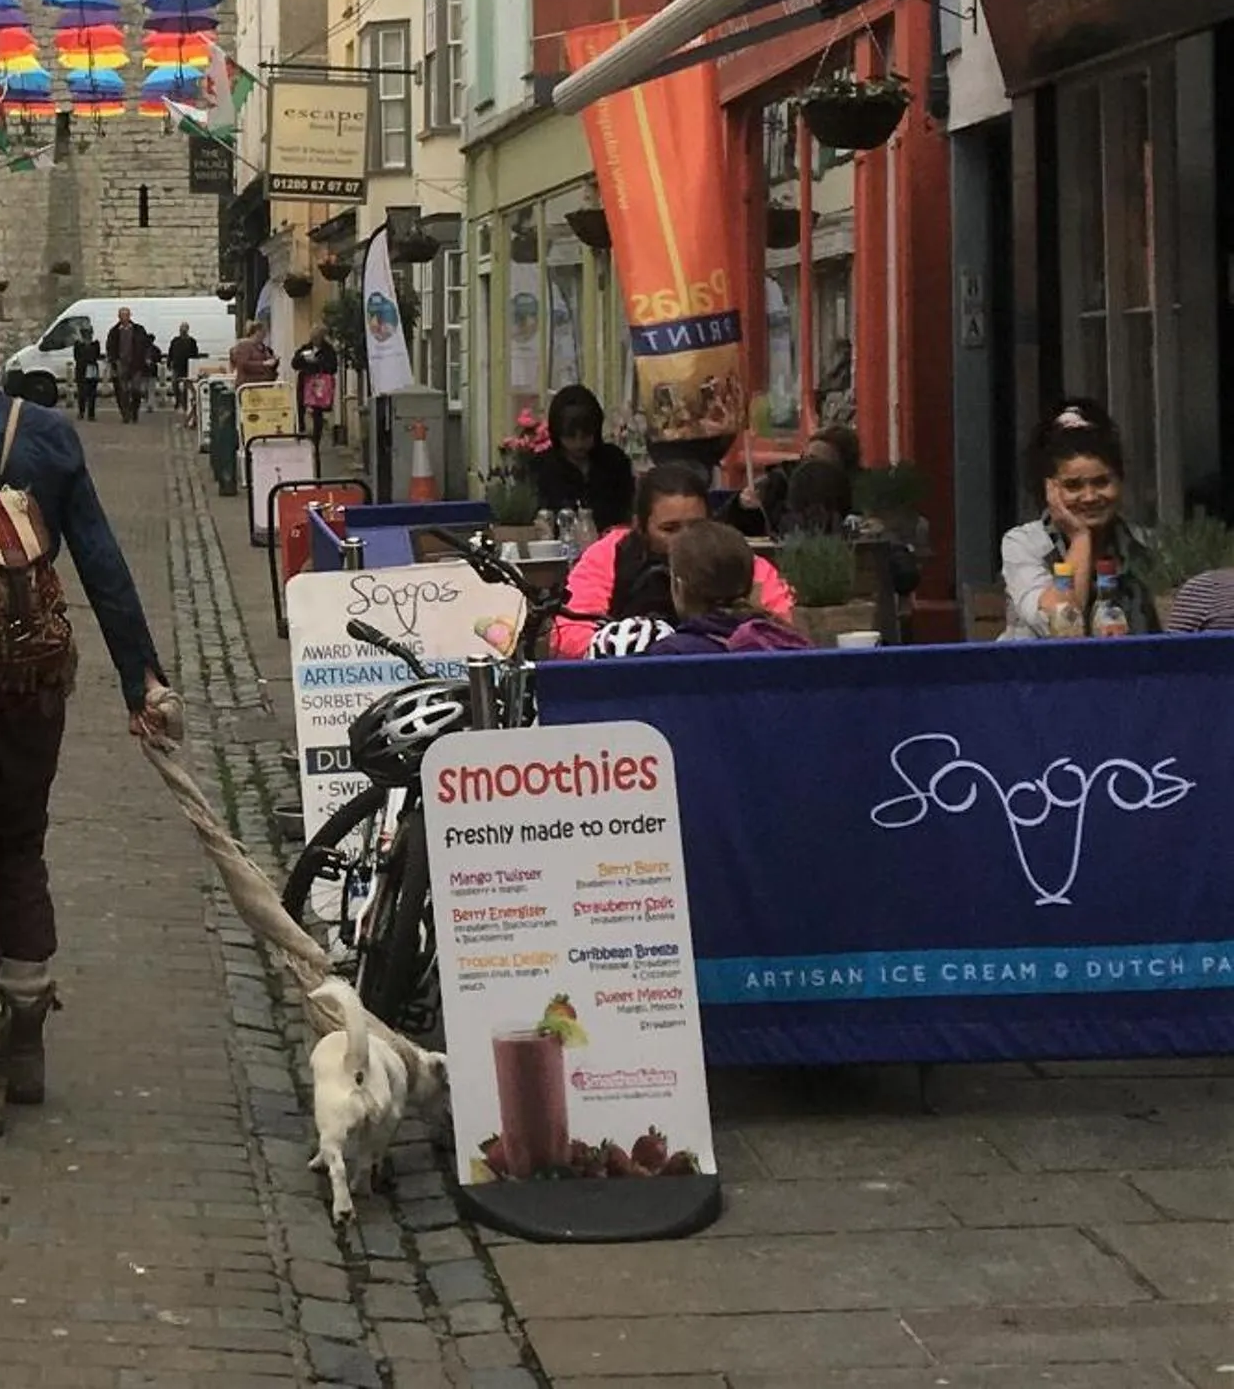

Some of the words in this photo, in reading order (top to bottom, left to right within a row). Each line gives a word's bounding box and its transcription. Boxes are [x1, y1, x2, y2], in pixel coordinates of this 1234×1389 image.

[283, 108, 364, 136] escape
[302, 644, 352, 660] AWARD
[303, 666, 383, 685] ARTISAN
[426, 661, 470, 678] REA
[438, 750, 658, 804] smoothies
[445, 824, 514, 848] freshly
[520, 819, 574, 843] made
[580, 819, 603, 836] to
[609, 814, 667, 835] order
[450, 872, 492, 887] Mango
[452, 908, 486, 922] Berry
[573, 899, 641, 917] Strawberry
[568, 946, 632, 964] Caribbean
[746, 968, 864, 989] ARTISAN
[882, 965, 927, 984] ICE
[942, 962, 1037, 982] CREAM
[1054, 962, 1068, 979] &
[1087, 956, 1183, 979] DUTCH
[1202, 956, 1232, 974] PA
